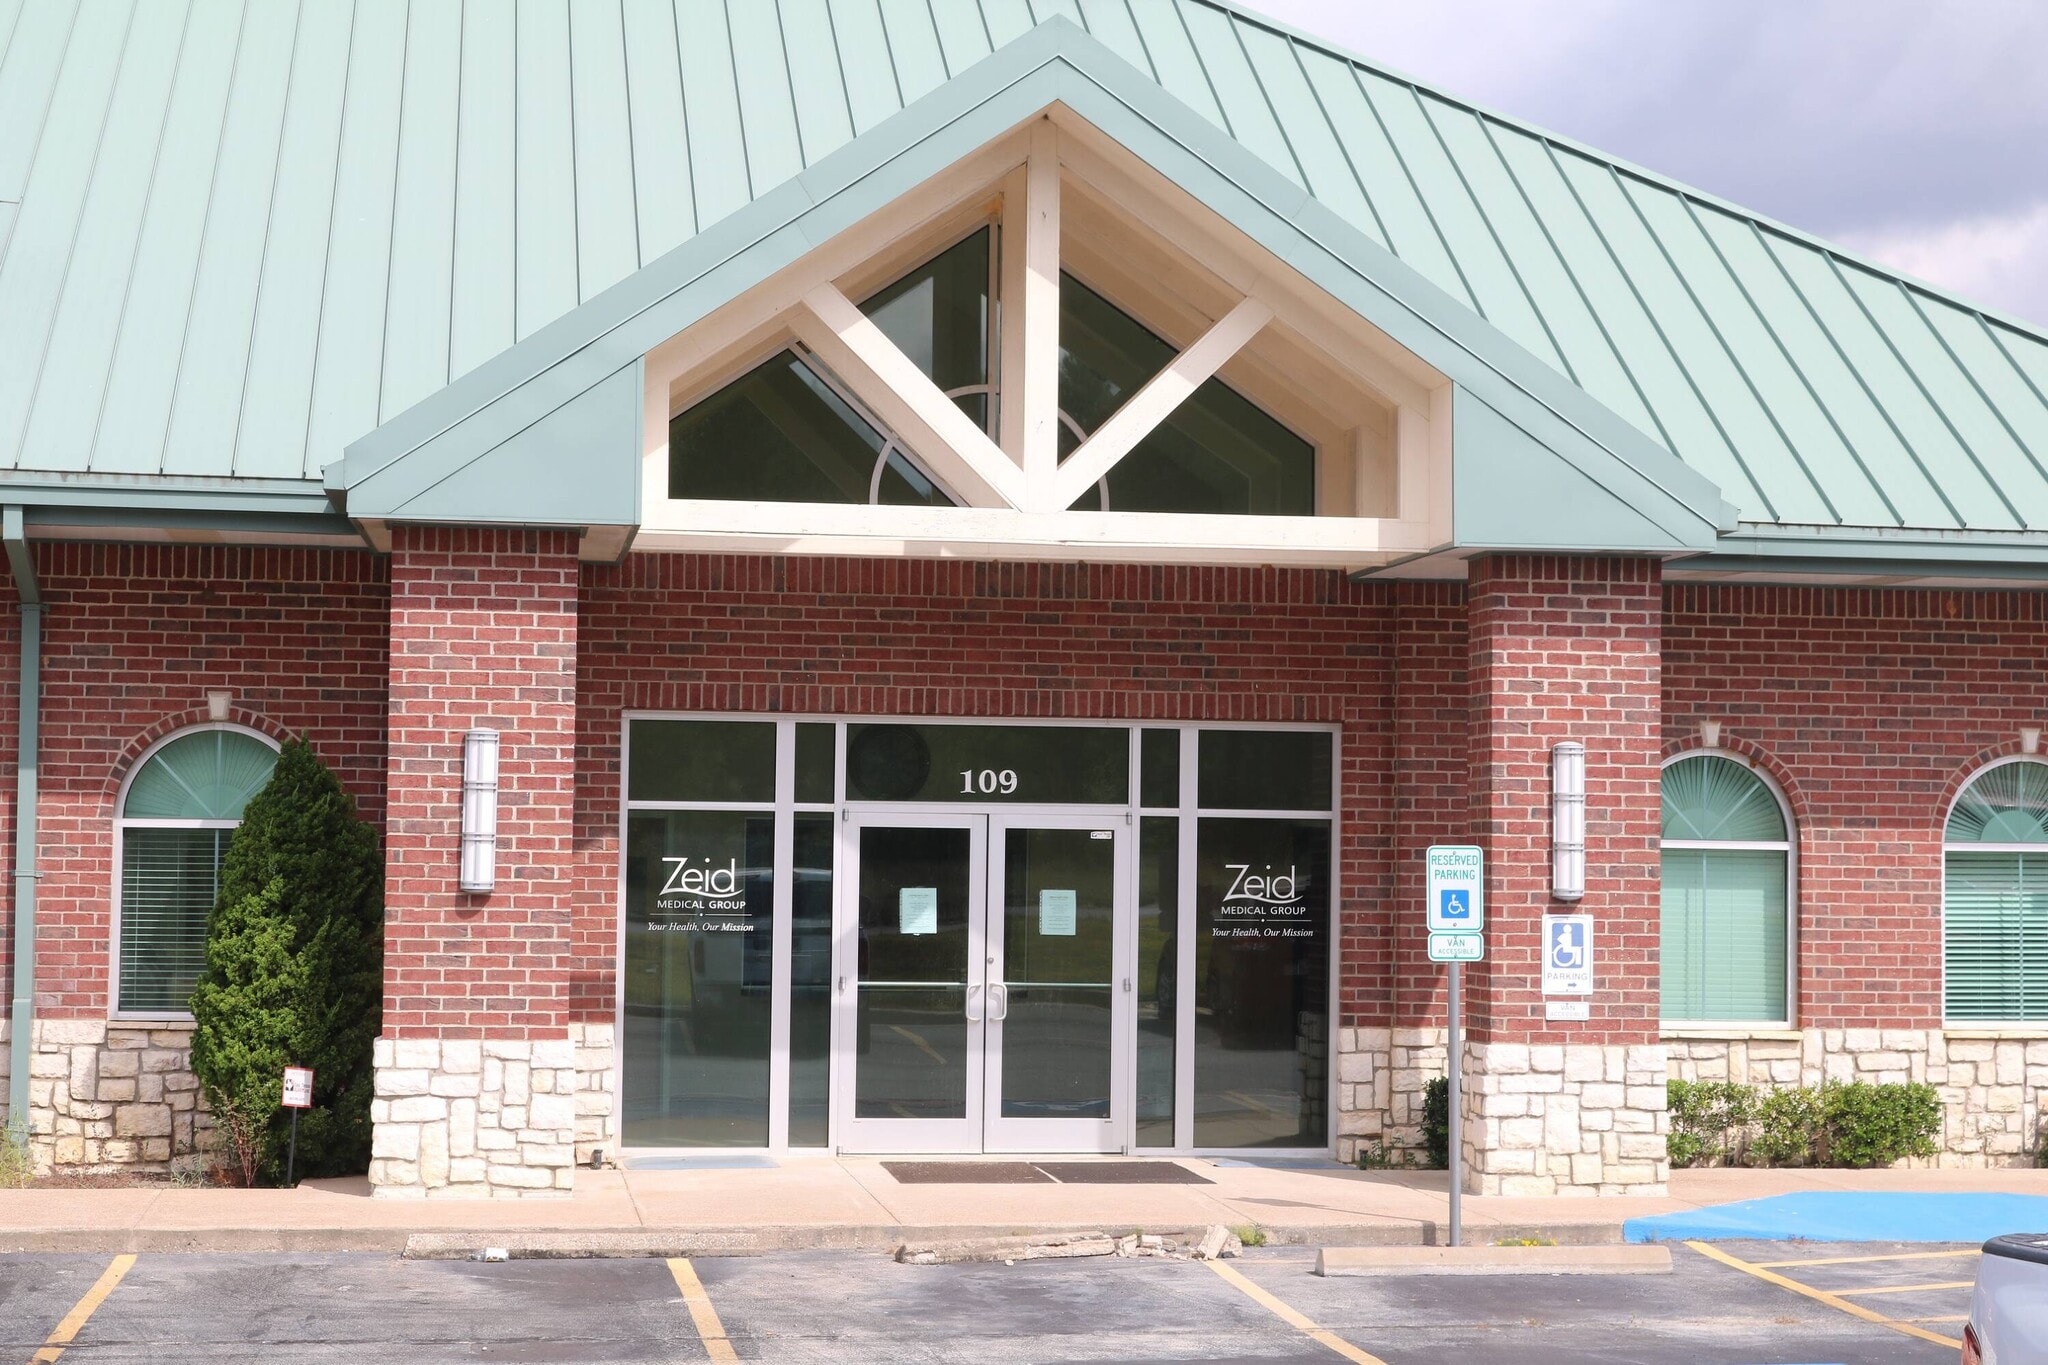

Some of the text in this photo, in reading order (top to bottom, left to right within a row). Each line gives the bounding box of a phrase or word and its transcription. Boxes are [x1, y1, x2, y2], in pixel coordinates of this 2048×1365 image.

[960, 769, 1018, 794] 109
[1431, 854, 1479, 866] RESERVED
[659, 857, 743, 898] Zeid
[1434, 869, 1476, 880] PARKING
[1222, 864, 1303, 904] Zeid
[657, 899, 746, 910] MEDICAL GROUP
[1221, 906, 1306, 915] MEDICAL GROUP
[647, 921, 754, 932] Your Health, Our Mission
[1212, 927, 1314, 937] Your Health, Our Mission
[1447, 939, 1465, 948] VAN
[1547, 972, 1588, 981] PARKING
